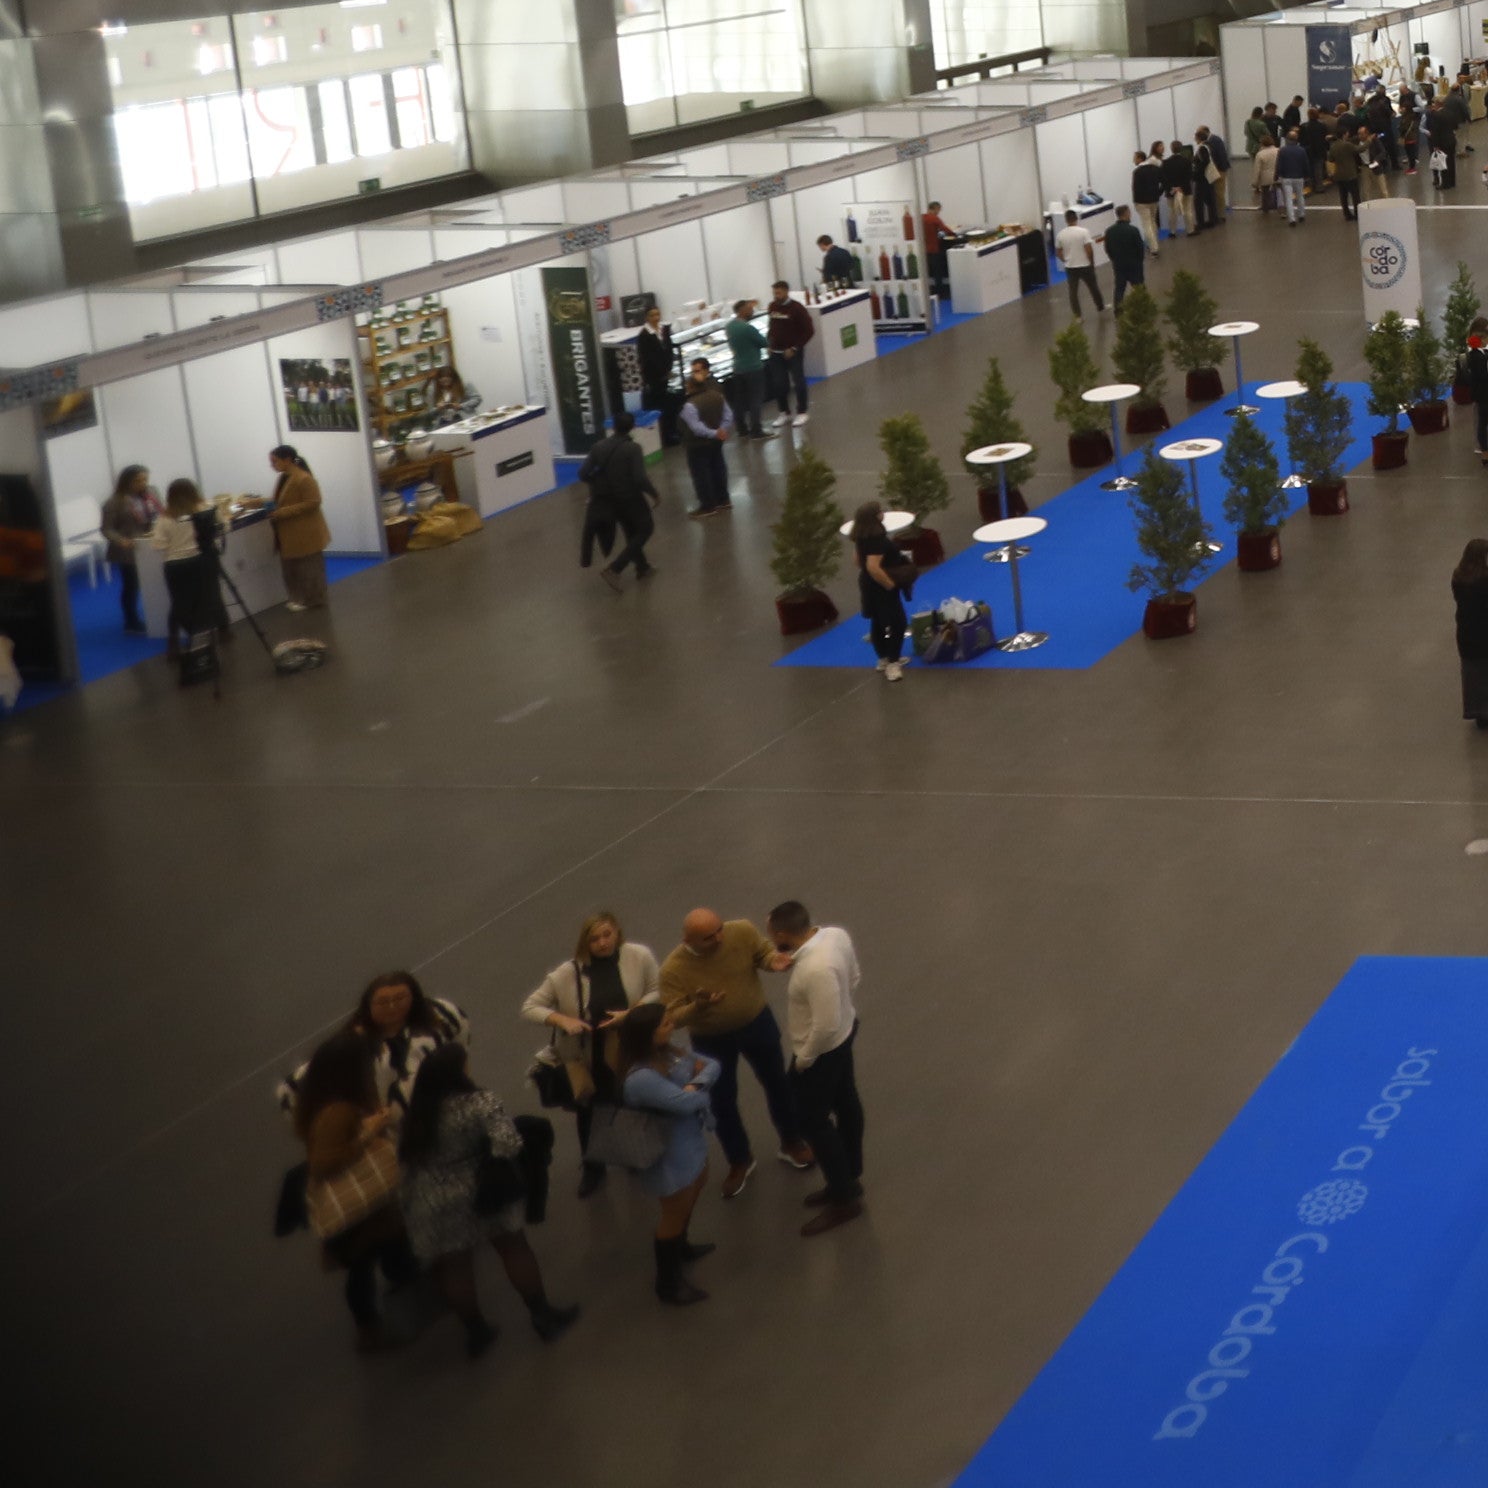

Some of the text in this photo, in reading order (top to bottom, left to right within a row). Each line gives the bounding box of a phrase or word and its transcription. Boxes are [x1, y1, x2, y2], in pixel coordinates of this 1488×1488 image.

[569, 329, 596, 435] BRIGANTES
[1359, 1046, 1438, 1140] sabor
[1330, 1145, 1373, 1171] a
